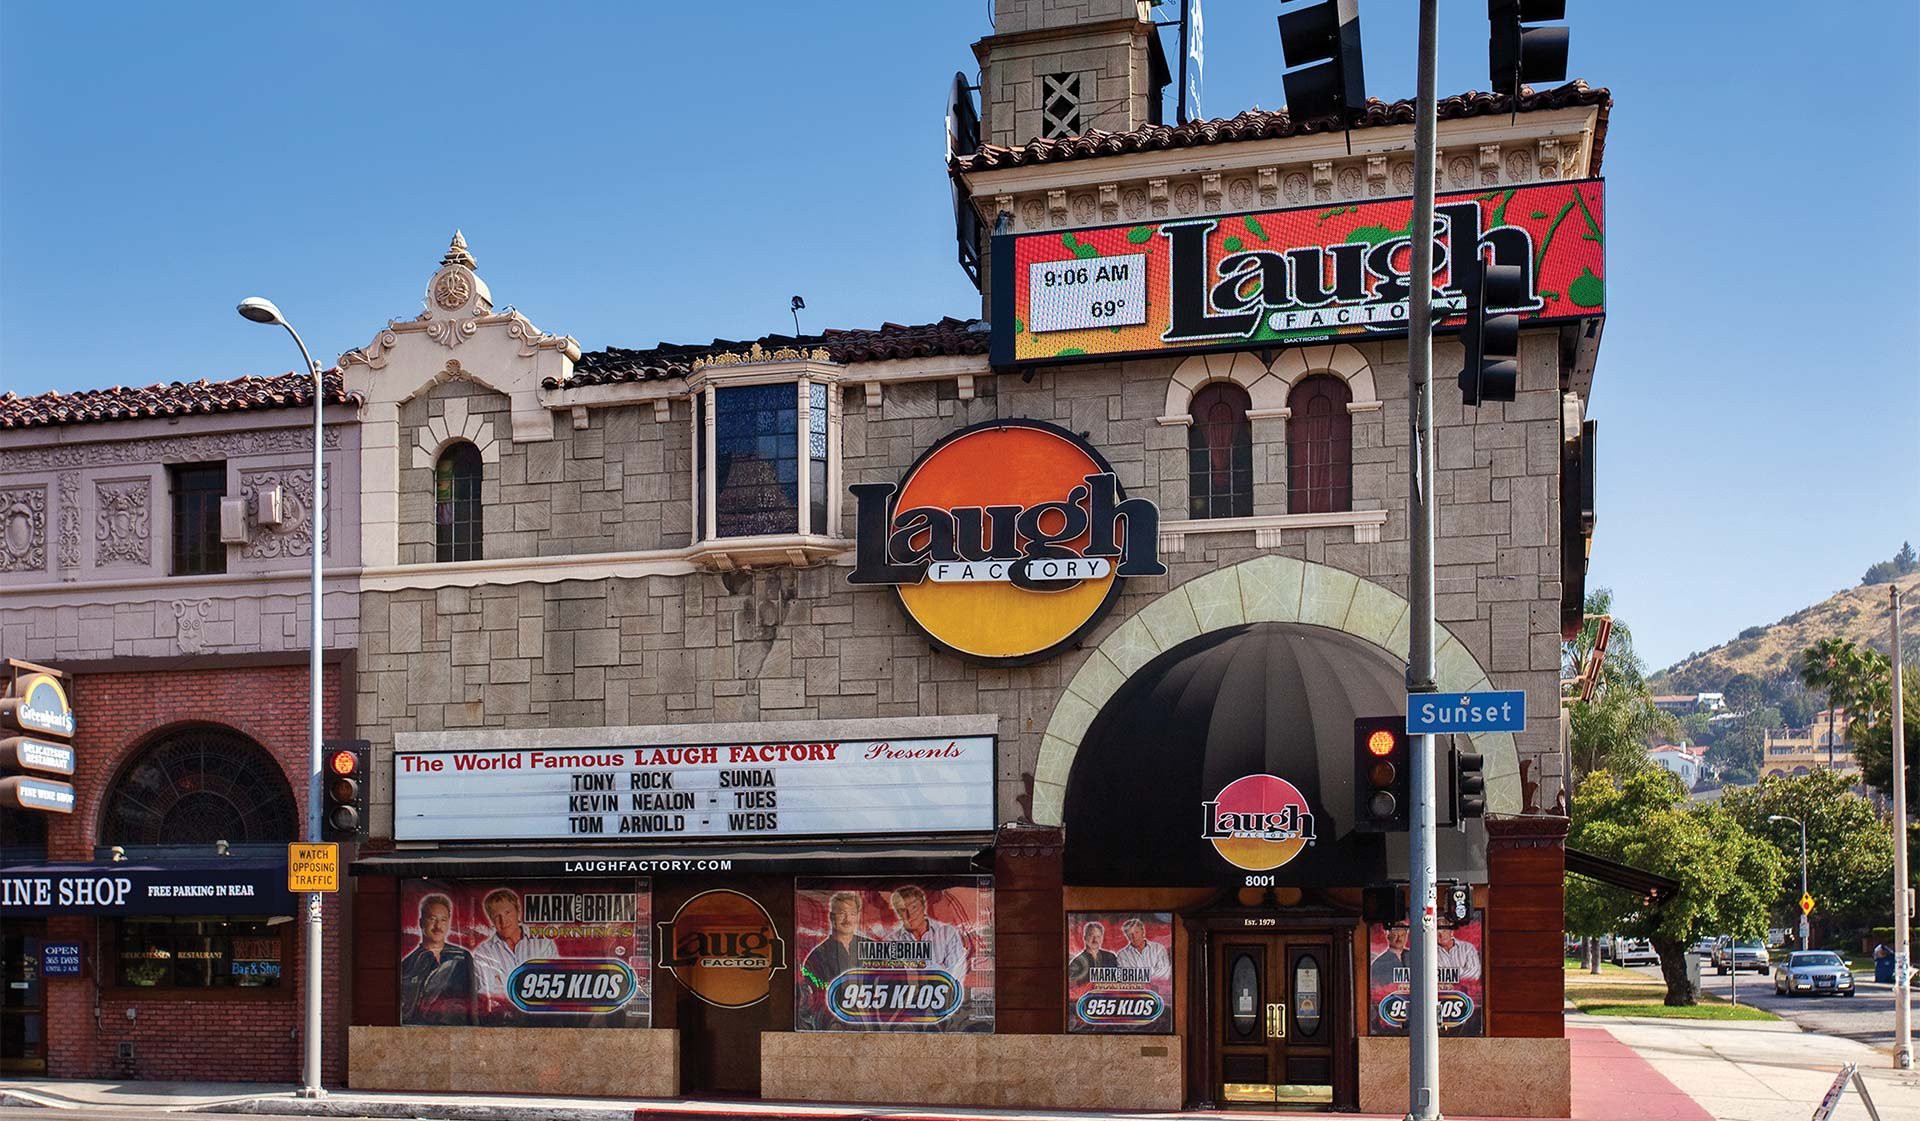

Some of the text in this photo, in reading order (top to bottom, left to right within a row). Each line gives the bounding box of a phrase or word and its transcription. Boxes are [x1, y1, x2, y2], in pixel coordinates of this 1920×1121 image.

[1044, 264, 1129, 287] 9:06 AM
[1286, 299, 1459, 327] FACTOY
[847, 472, 1168, 592] Laugh
[938, 560, 1100, 580] FACTORY
[1421, 701, 1512, 724] Sunset
[400, 741, 966, 772] The World Famous LAUGH FACTORY Presents
[572, 770, 775, 791] TONY ROCK SUNDA
[569, 795, 618, 812] KEVIN
[632, 792, 695, 810] NEALON
[734, 791, 777, 809] TUES
[569, 816, 603, 833] TOM
[618, 814, 685, 833] ARNOLD
[728, 812, 777, 831] WEDS
[1201, 801, 1317, 843] Laugh
[299, 850, 328, 859] WATCH
[293, 862, 335, 872] OPPOSING
[565, 860, 732, 872] LAUGHFACTORY.COM
[296, 875, 332, 885] TRAFFIC
[1245, 875, 1276, 887] 8001
[59, 877, 132, 906] SHOP
[148, 884, 255, 897] FREE PARKING IN REAR
[525, 894, 574, 921] MARK
[584, 894, 636, 921] BRIAN
[529, 926, 634, 938] MORNINGS
[45, 946, 79, 955] OPEN
[859, 942, 891, 959] MARK
[897, 942, 931, 959] BRIAN
[46, 957, 59, 965] 365
[232, 962, 249, 975] Bar
[250, 962, 259, 975] &
[1090, 968, 1118, 982] MARK
[1122, 968, 1150, 982] BRIAN
[1394, 968, 1458, 983] MA RIAN
[567, 974, 623, 999] KLOS
[890, 984, 949, 1009] KLOS
[1117, 999, 1154, 1016] KLOS
